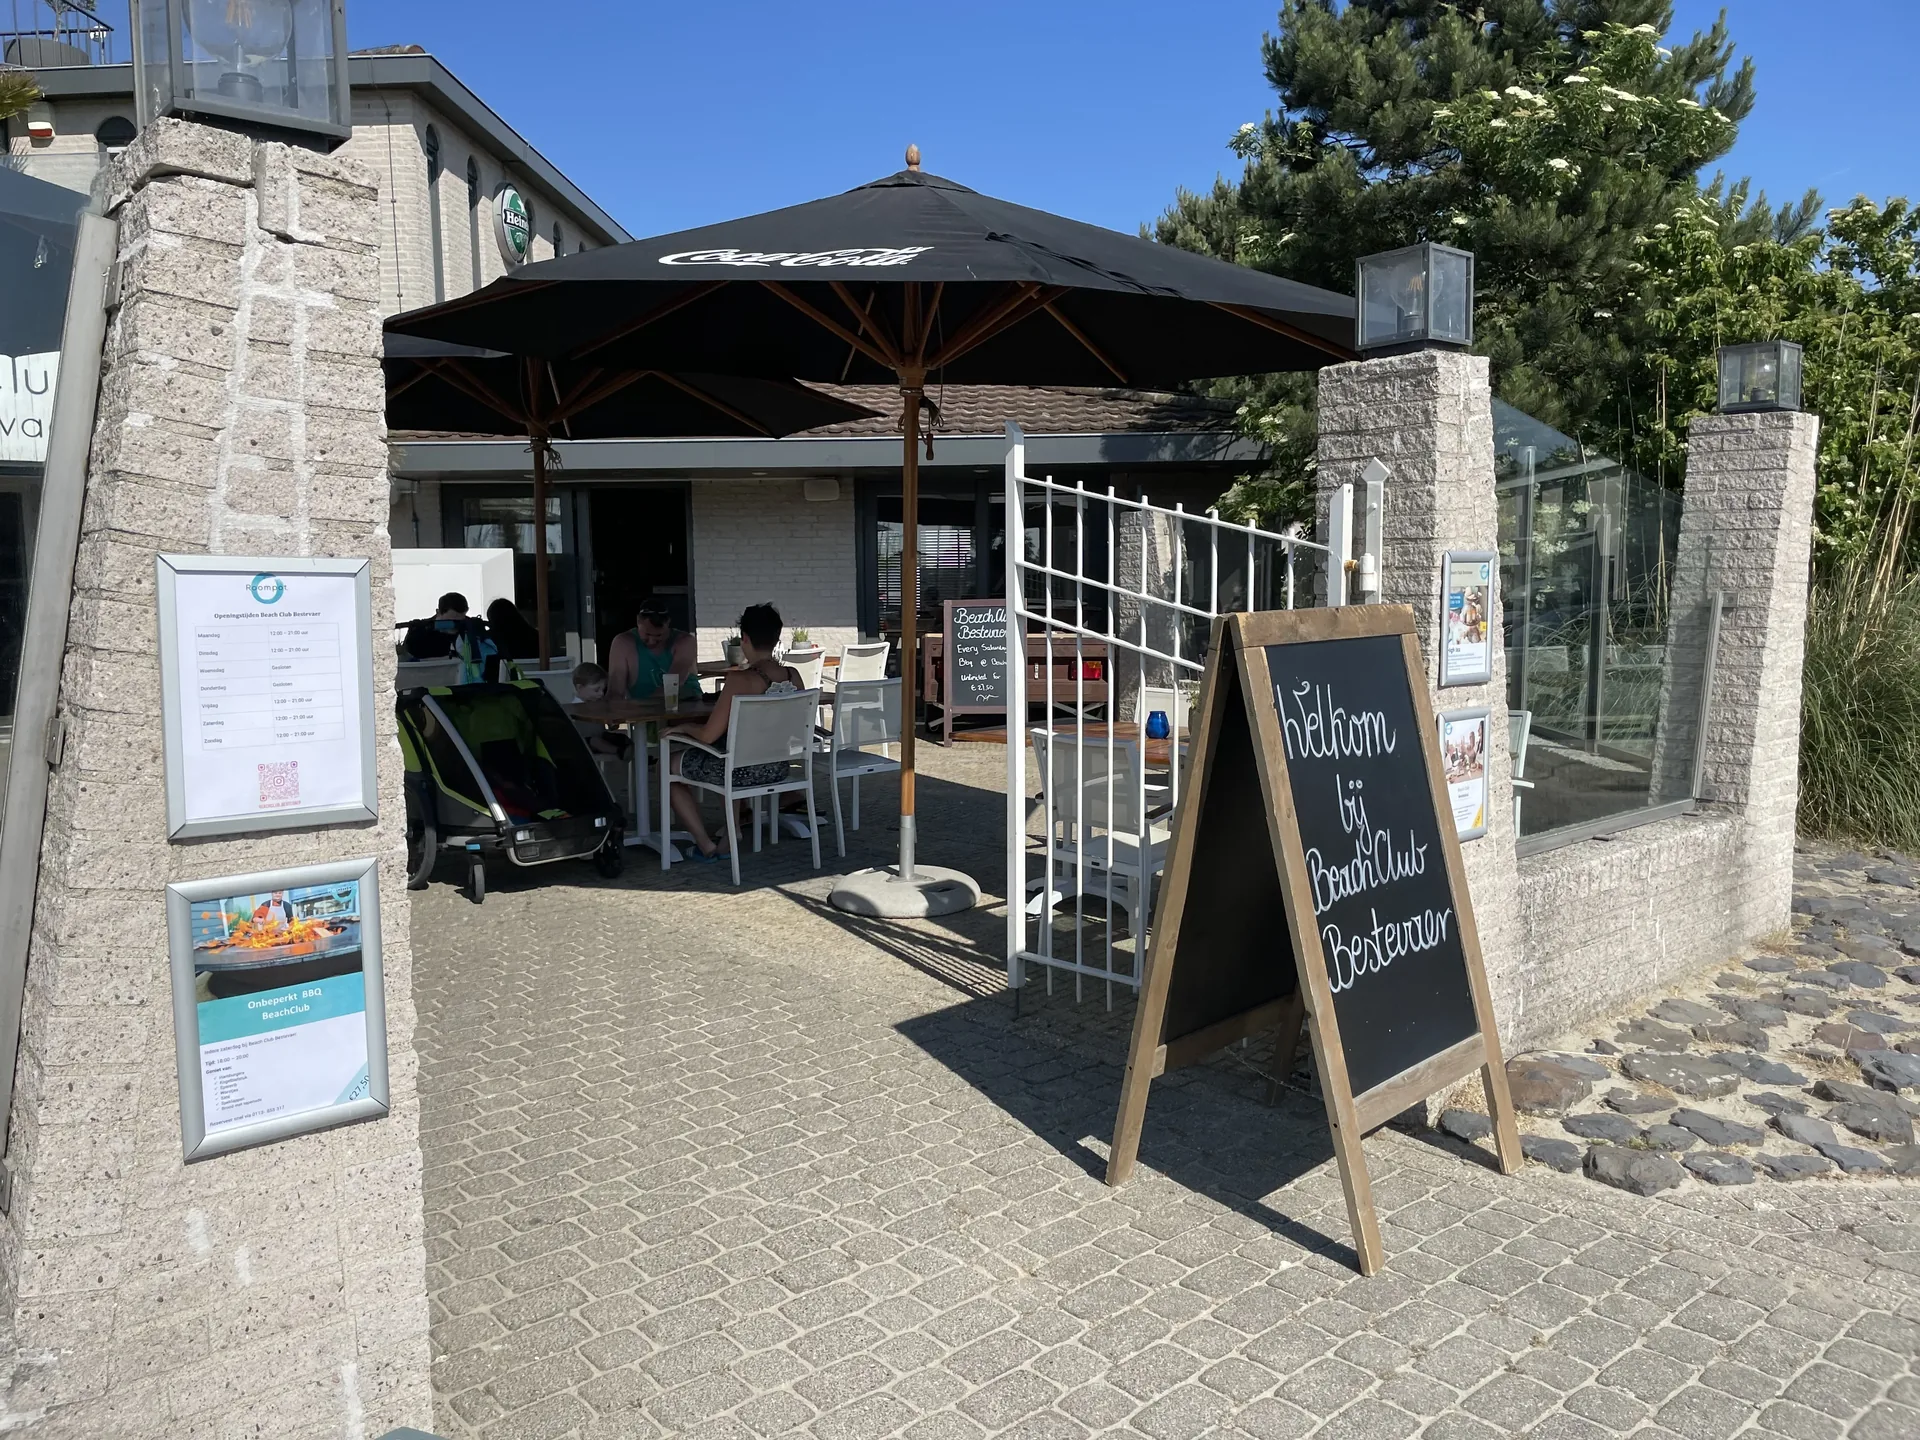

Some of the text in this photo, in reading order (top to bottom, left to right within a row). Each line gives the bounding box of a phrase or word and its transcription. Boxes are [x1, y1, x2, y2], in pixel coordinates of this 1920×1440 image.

[658, 246, 935, 267] Coca-Cola
[246, 584, 288, 592] Roompot
[957, 644, 979, 655] Every
[981, 658, 988, 667] @
[1277, 681, 1397, 760] Welkom
[1336, 773, 1372, 855] bij
[1322, 907, 1453, 994] Bestevaer
[247, 987, 322, 1009] Onbeperkt BBQ
[262, 1003, 310, 1020] BeachClub
[220, 1044, 241, 1052] zaterdag
[349, 1075, 369, 1101] €27,50
